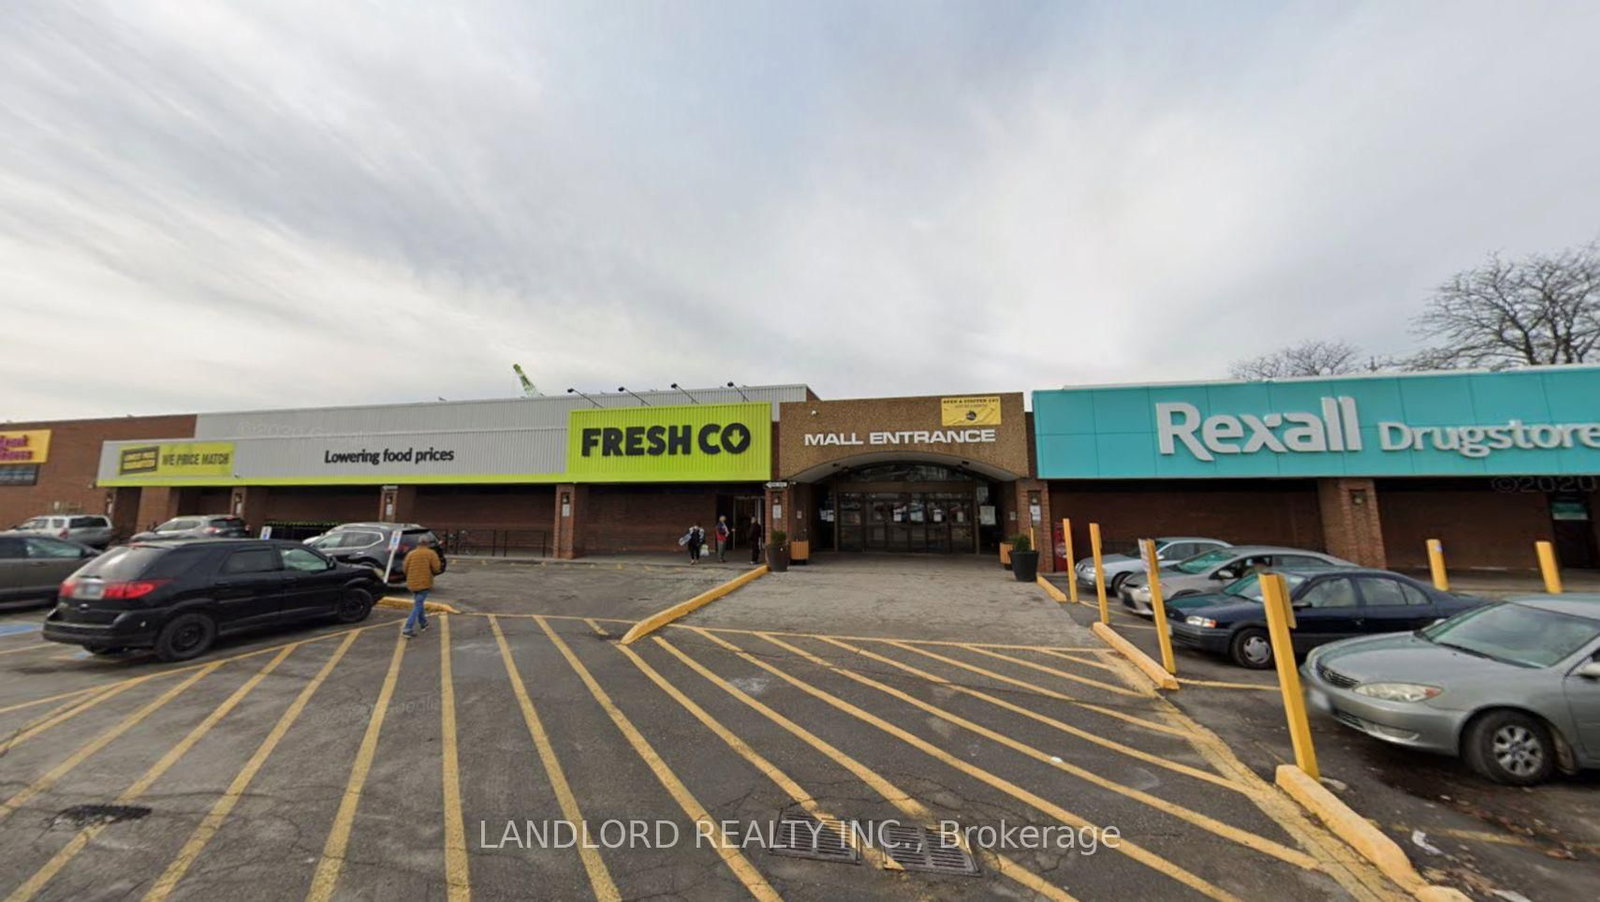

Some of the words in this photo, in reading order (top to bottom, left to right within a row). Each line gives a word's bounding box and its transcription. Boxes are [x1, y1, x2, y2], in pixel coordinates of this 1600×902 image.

[581, 424, 692, 457] FRESH
[698, 422, 751, 455] CO
[804, 432, 863, 446] MALL
[869, 428, 996, 445] ENTRANCE
[1155, 396, 1363, 461] Rexall
[1378, 419, 1600, 459] Drugstore
[176, 453, 200, 466] PRICE
[201, 452, 230, 465] MATCH
[324, 448, 380, 466] Lowering
[383, 447, 413, 462] food
[415, 446, 455, 465] prices
